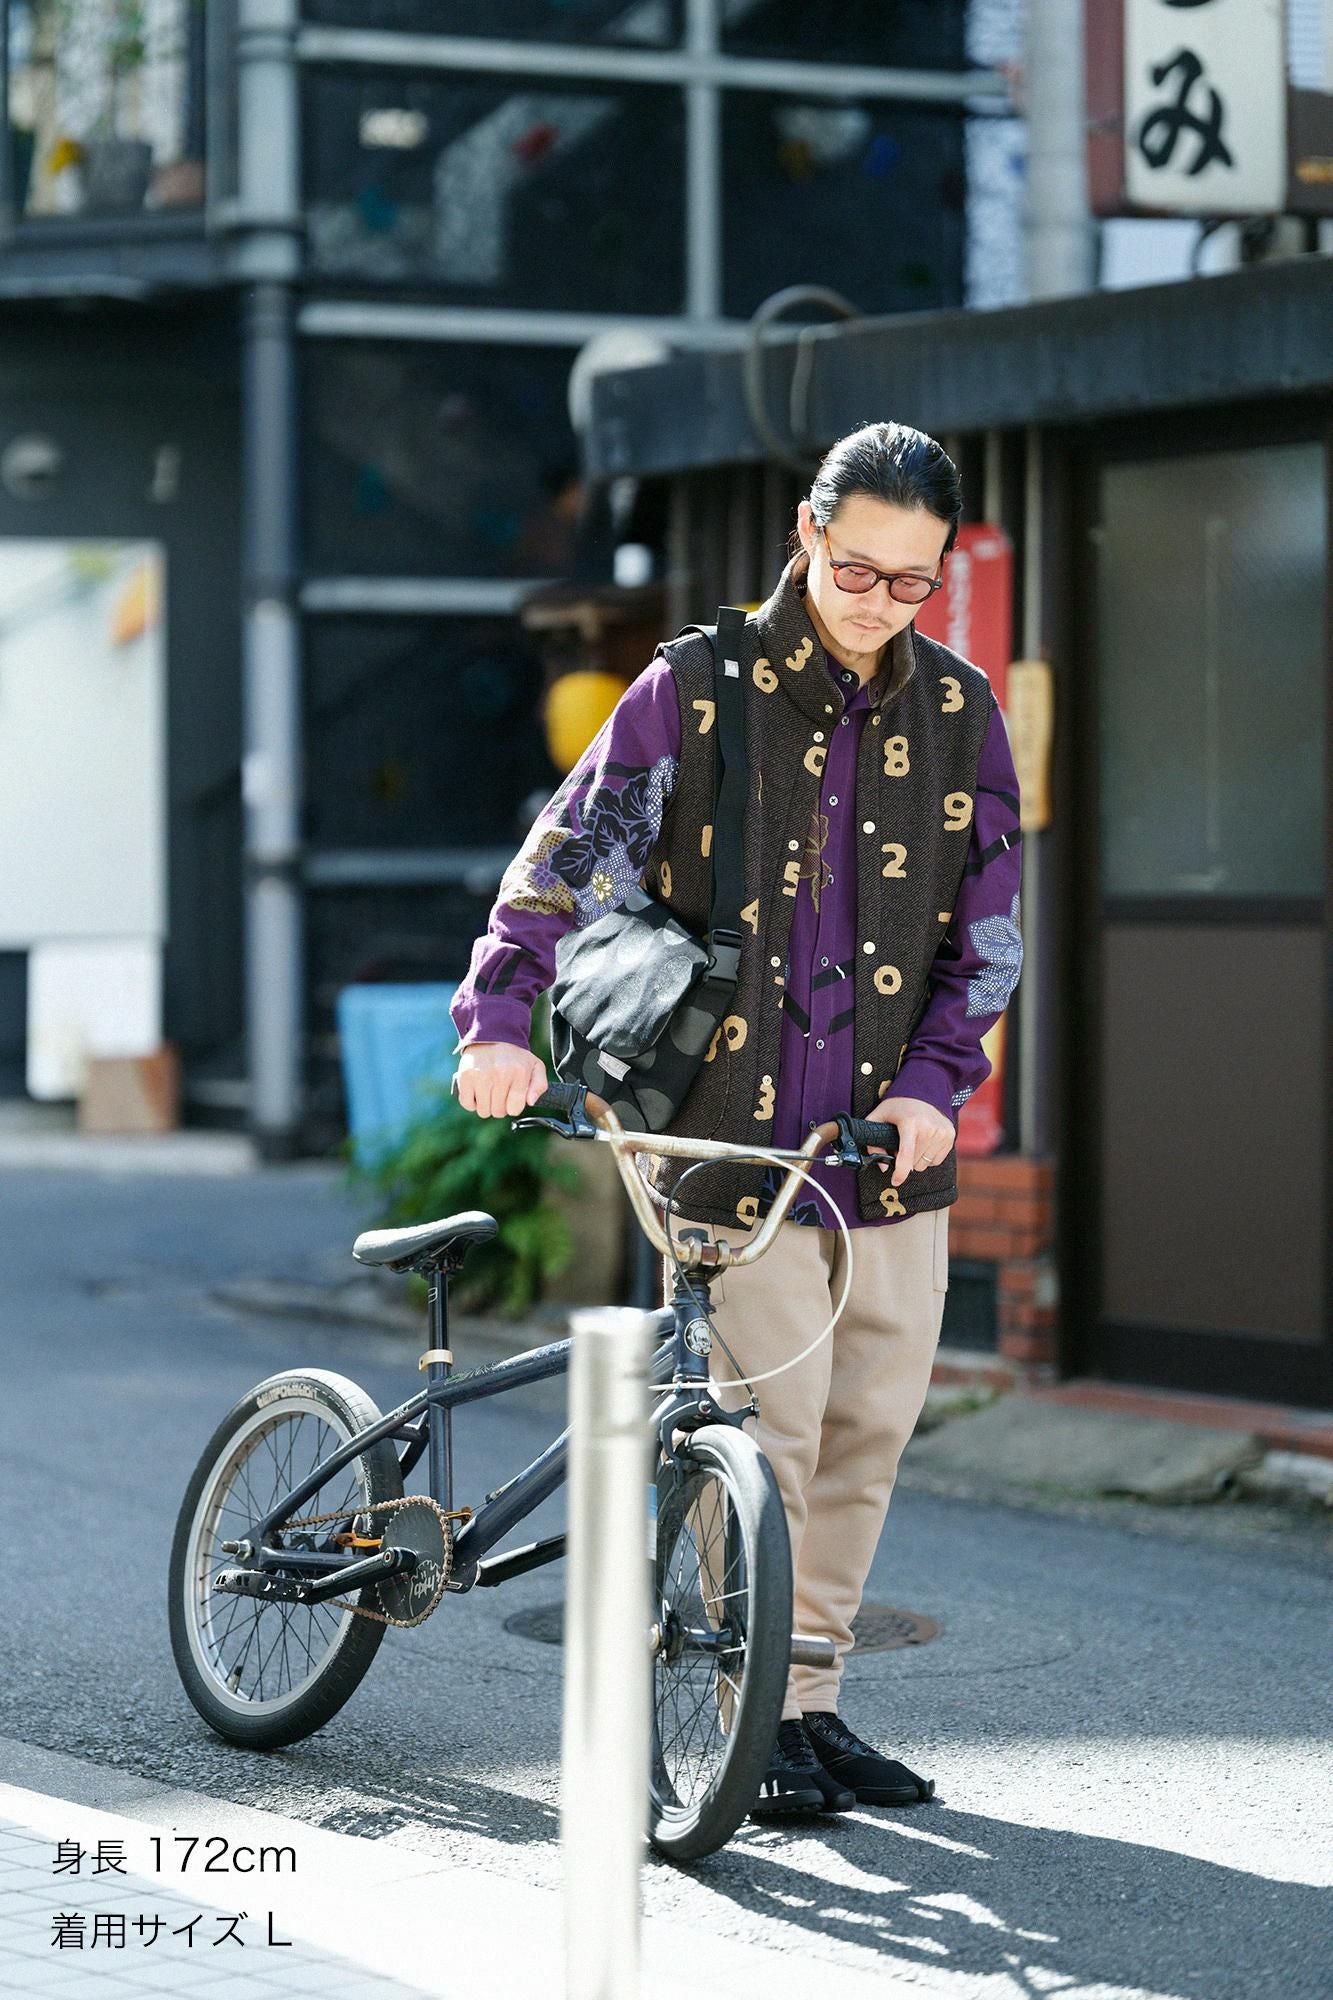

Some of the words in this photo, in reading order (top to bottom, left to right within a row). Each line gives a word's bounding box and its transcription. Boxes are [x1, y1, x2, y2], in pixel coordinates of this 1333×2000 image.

[1136, 0, 1234, 176] み
[752, 658, 779, 694] 6
[939, 677, 965, 713] 3
[692, 699, 716, 734] 7
[883, 735, 911, 778] 8
[943, 791, 974, 832] 9
[881, 842, 908, 878] 2
[873, 964, 903, 996] 0
[753, 1081, 776, 1121] 3
